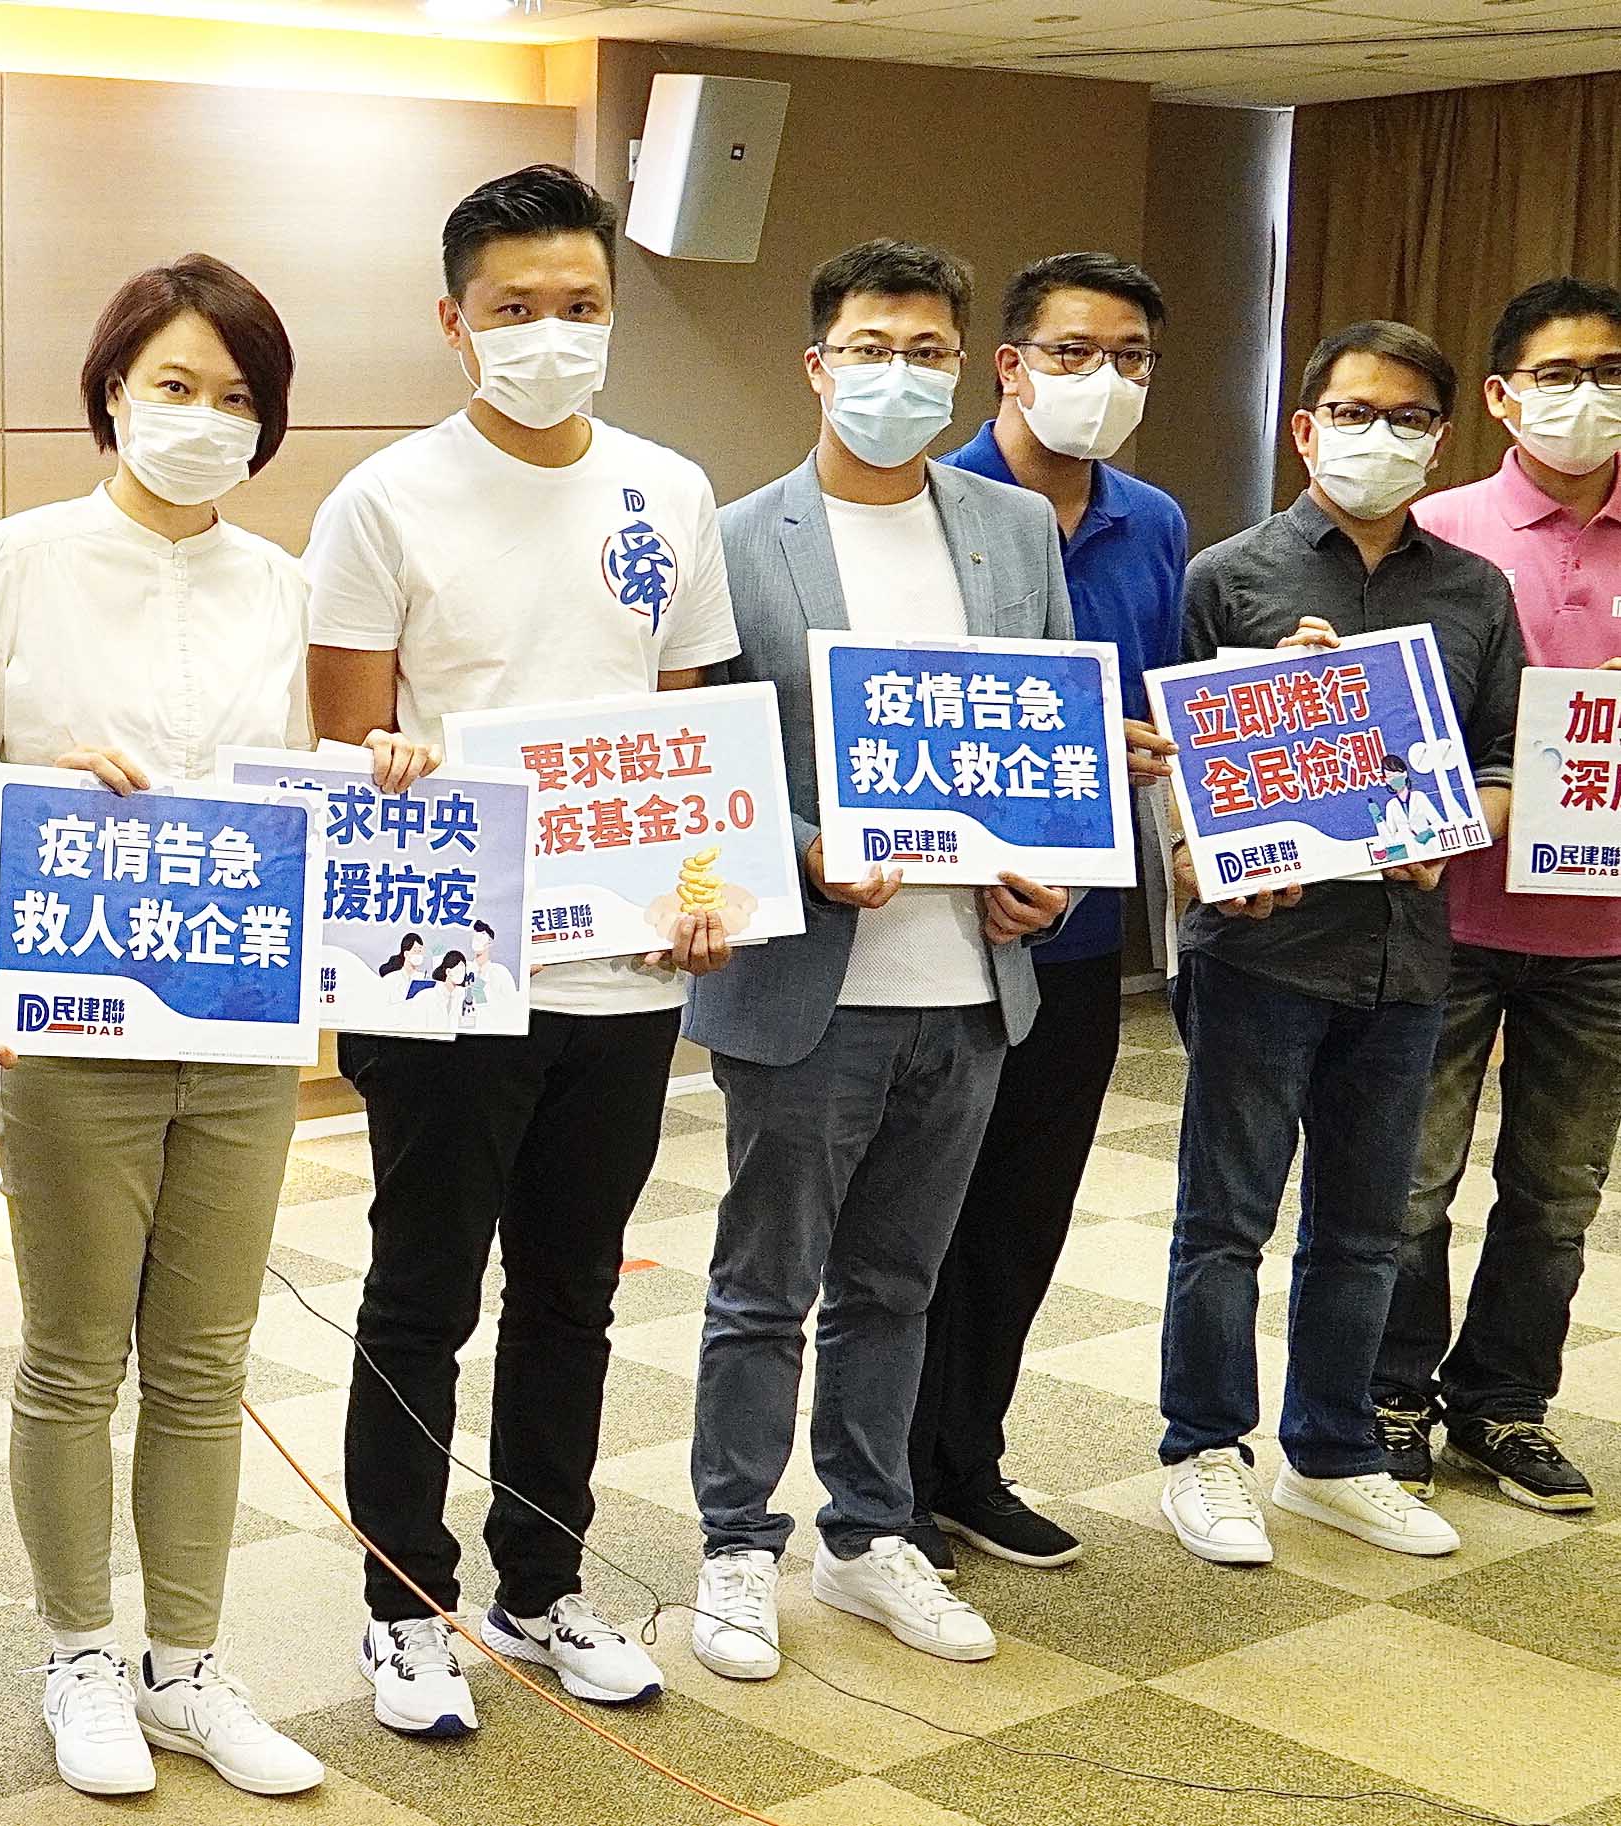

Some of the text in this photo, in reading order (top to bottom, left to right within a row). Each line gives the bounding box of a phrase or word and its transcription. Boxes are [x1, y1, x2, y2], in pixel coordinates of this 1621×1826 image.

[863, 670, 1065, 731] 疫情告急
[1186, 665, 1370, 747] 立即推行
[1564, 691, 1621, 744] 加
[521, 728, 712, 792] 要求設立
[848, 738, 1100, 801] 救人救企業
[1204, 731, 1385, 817] 全民檢測
[1560, 759, 1621, 811] 深
[279, 780, 479, 853] 求中央
[535, 789, 755, 857] 疫基金3.0
[894, 829, 958, 853] 民建聯
[38, 814, 261, 889] 疫情告急
[926, 854, 958, 863] DAB
[1242, 840, 1298, 868] 民建聯
[1273, 862, 1302, 874] DAB
[1560, 845, 1621, 866] 民建聯
[1587, 868, 1620, 876] DAB
[323, 859, 477, 928] 援抗疫
[531, 904, 593, 932] 民建聯
[11, 890, 292, 969] 救人救企業
[559, 929, 594, 941] DAB
[52, 996, 125, 1024] 民建聯
[87, 1026, 124, 1036] DAB
